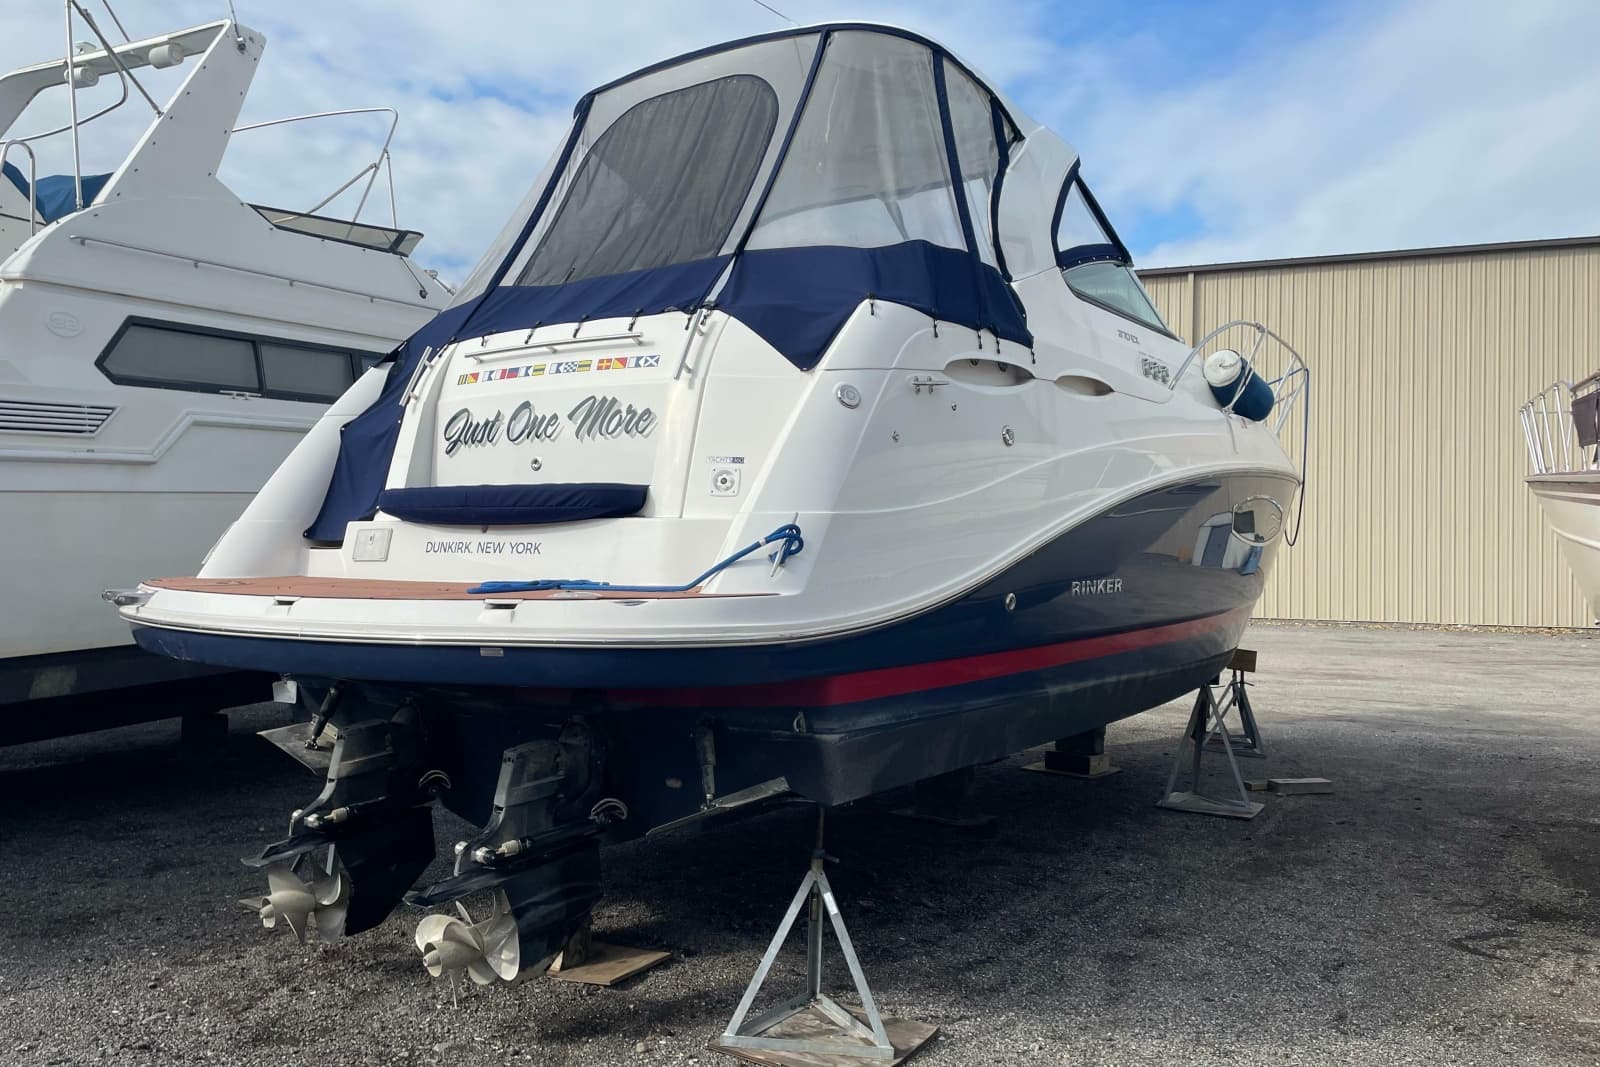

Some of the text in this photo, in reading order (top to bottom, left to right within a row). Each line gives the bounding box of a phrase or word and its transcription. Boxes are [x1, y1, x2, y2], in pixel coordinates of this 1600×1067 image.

[443, 395, 658, 456] Just One More
[476, 542, 506, 554] NEW
[509, 542, 542, 555] YORK
[1071, 578, 1123, 596] RINKER
